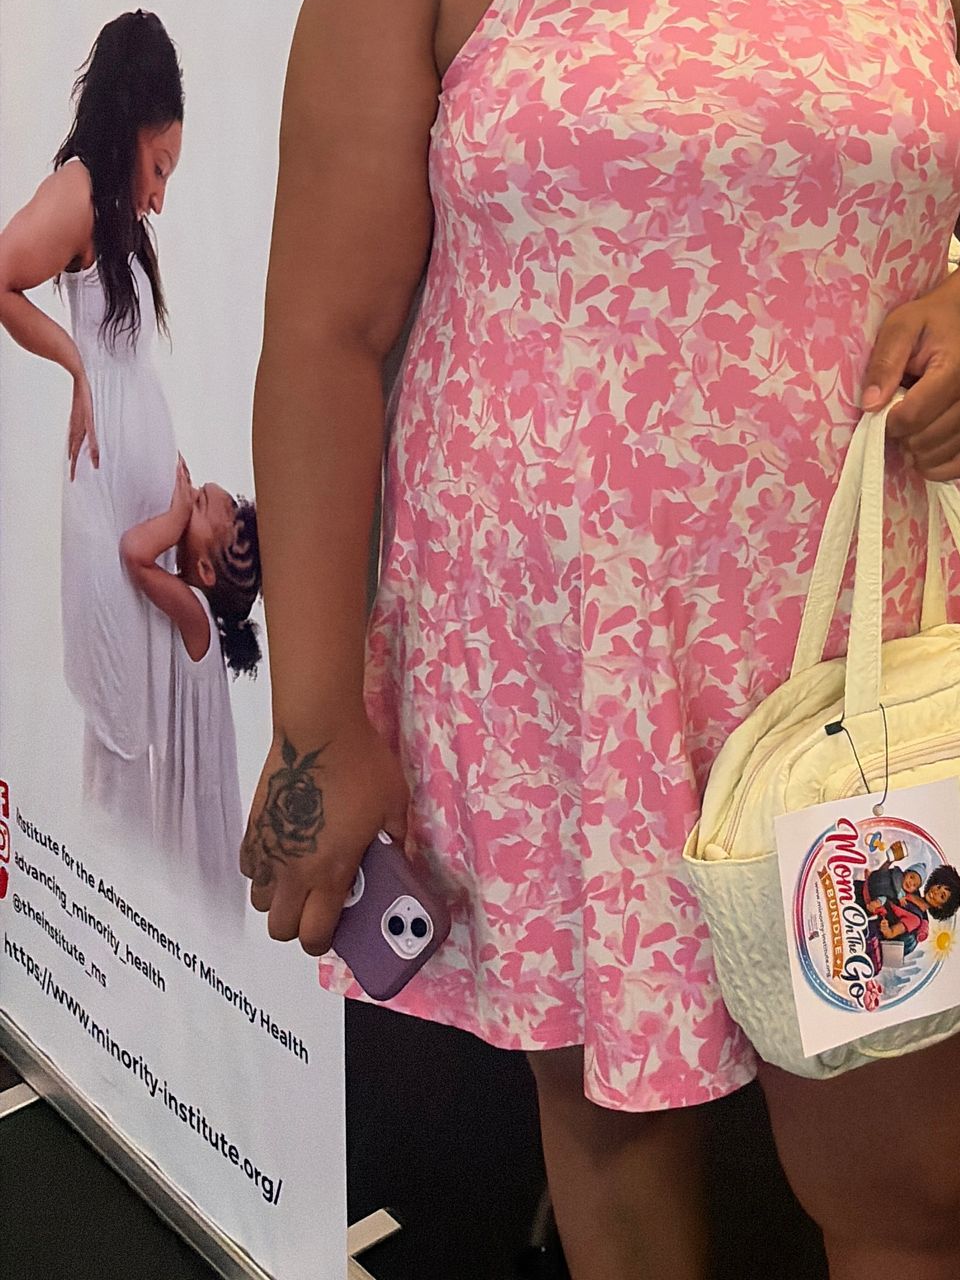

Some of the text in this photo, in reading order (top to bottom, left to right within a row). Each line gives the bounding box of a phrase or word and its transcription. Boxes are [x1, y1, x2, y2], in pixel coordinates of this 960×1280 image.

[12, 893, 107, 988] @theinstitute_ms
[14, 851, 167, 993] advancing_minority_health
[61, 844, 75, 871] for
[76, 860, 95, 889] the
[97, 878, 182, 962] Advancement
[183, 951, 200, 974] of
[199, 959, 258, 1024] Minority
[259, 1013, 310, 1065] Health
[825, 818, 874, 1009] Mom On The Go
[826, 887, 842, 955] BUNDLE
[4, 931, 283, 1206] https://www.minority-institute.org/
